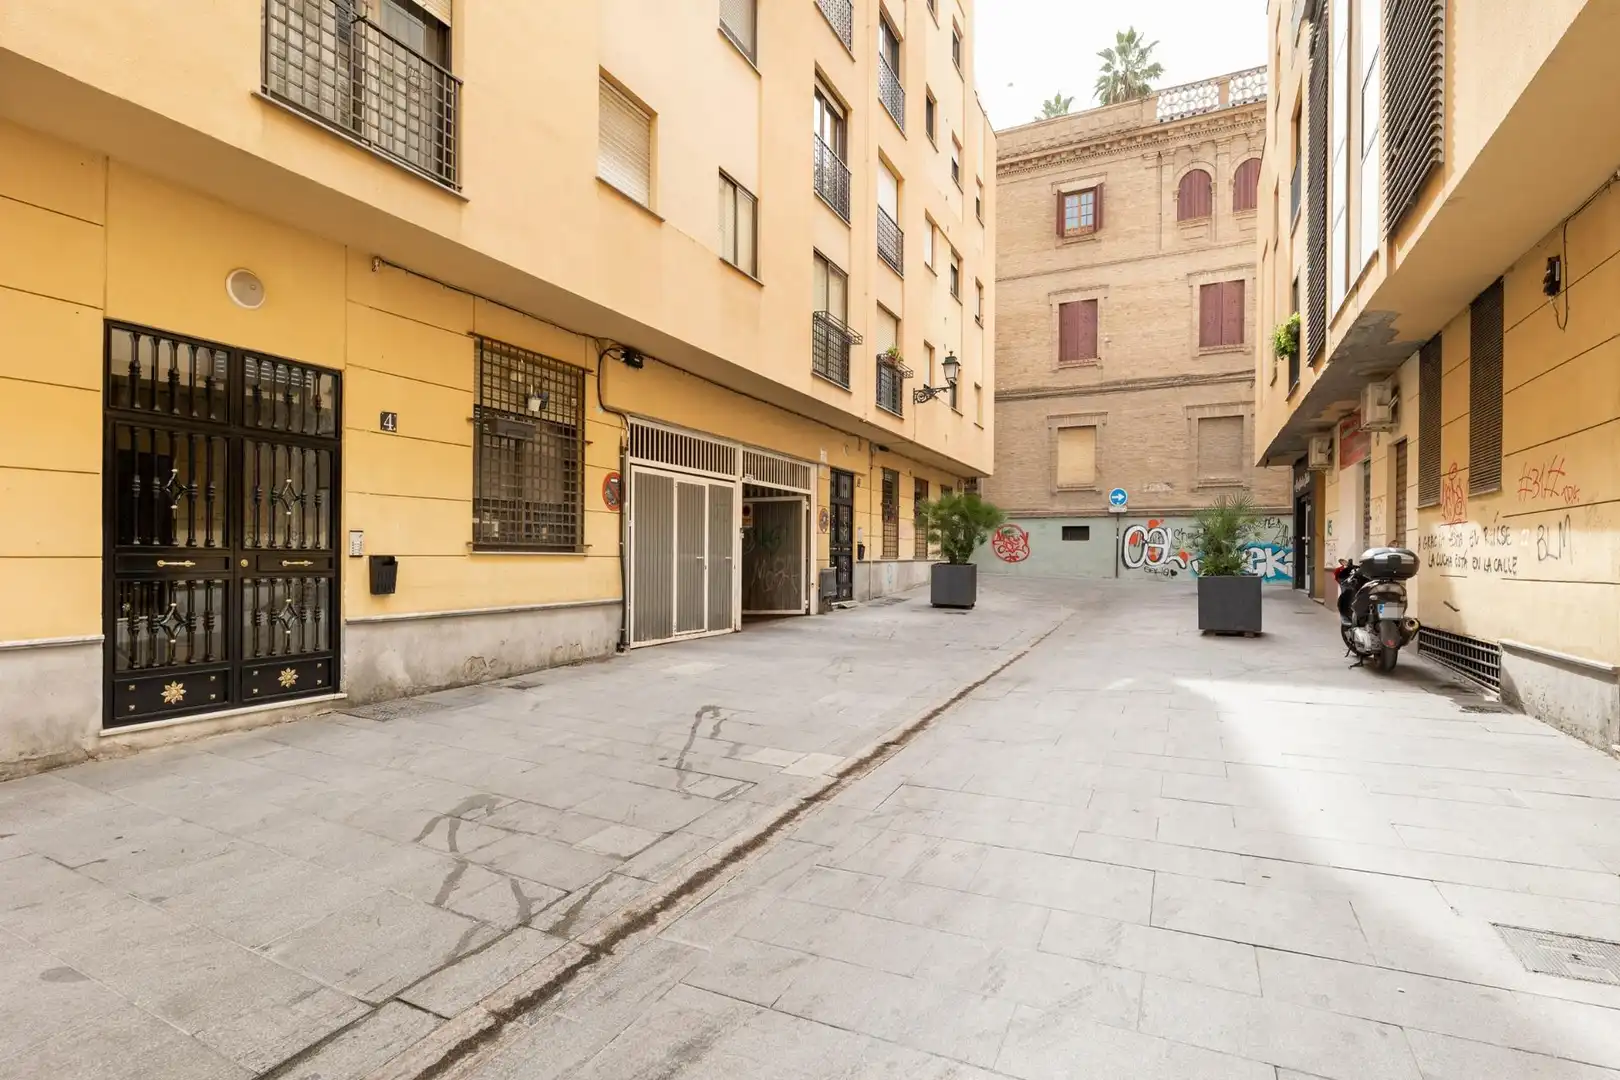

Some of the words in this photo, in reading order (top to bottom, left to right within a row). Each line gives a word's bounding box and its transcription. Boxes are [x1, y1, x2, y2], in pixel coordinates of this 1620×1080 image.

[383, 413, 394, 430] 4
[1537, 514, 1573, 565] BLM
[1494, 556, 1518, 575] CALLE
